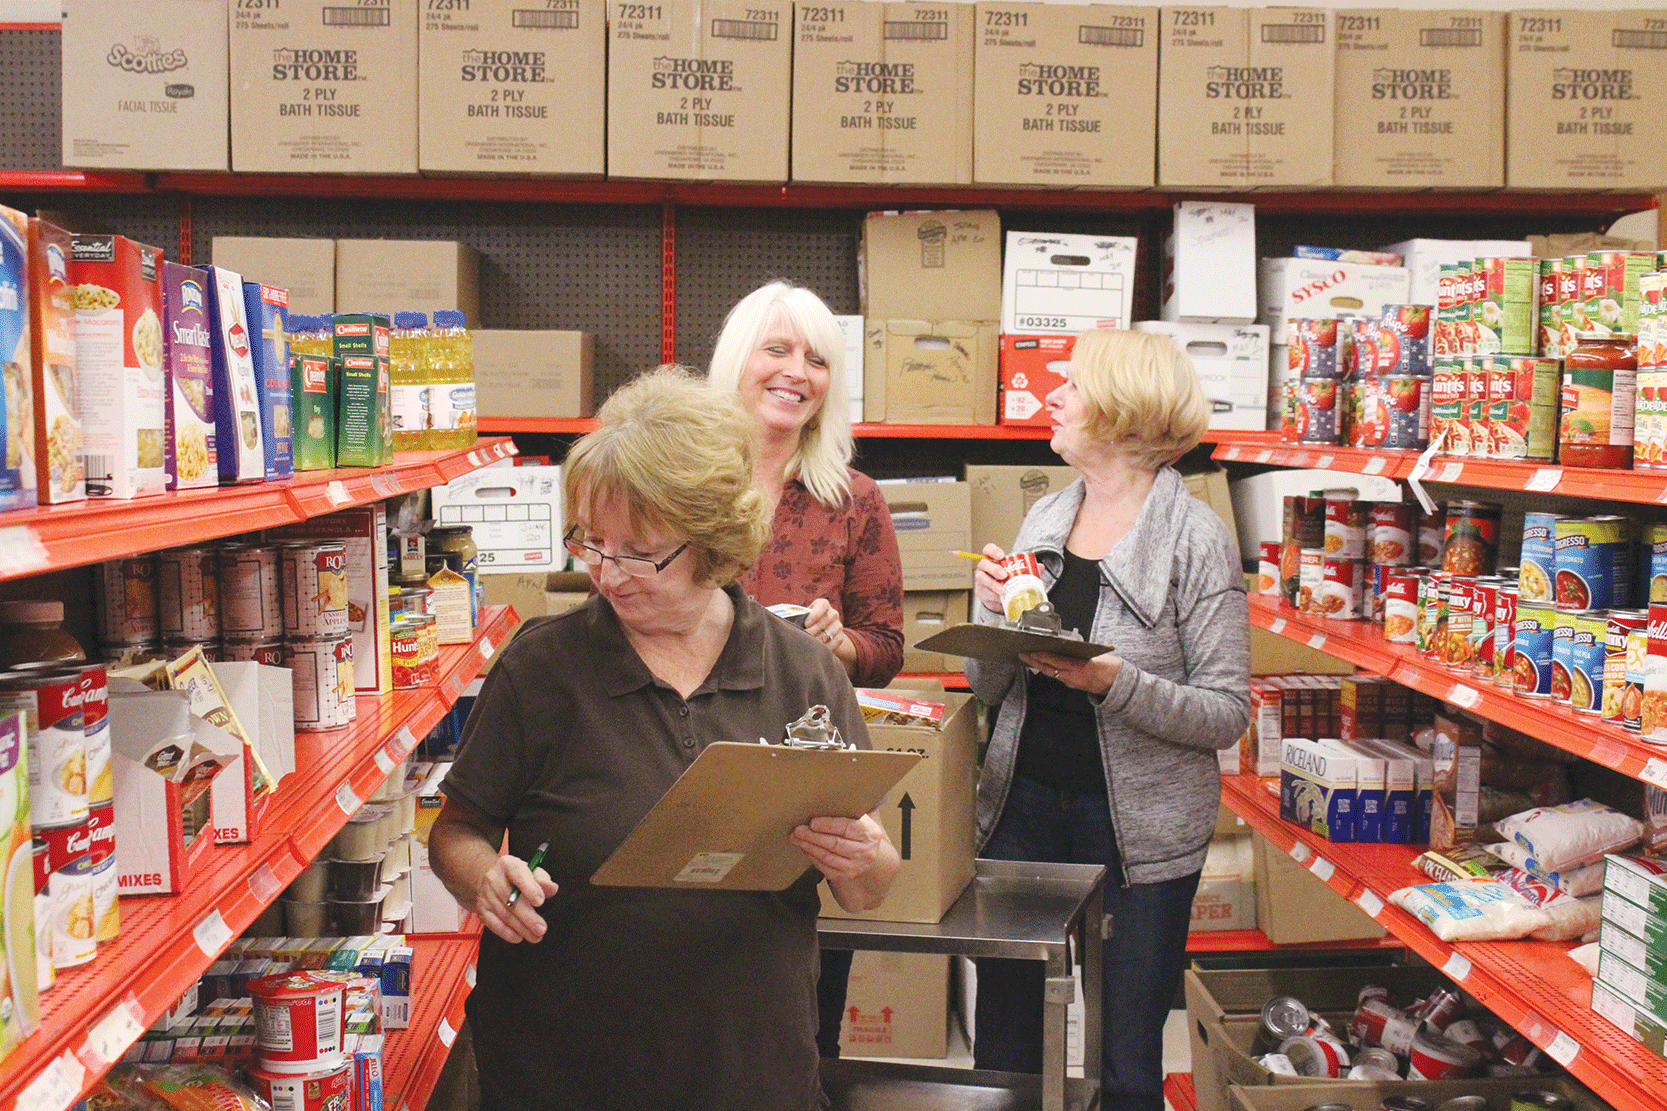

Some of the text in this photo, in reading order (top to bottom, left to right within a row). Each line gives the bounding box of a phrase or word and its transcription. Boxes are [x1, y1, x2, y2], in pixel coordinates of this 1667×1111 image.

[619, 4, 662, 20] 72311
[746, 9, 779, 20] 72311
[802, 7, 844, 23] 72311
[914, 10, 948, 20] 72311
[985, 11, 1028, 27] 72311
[1173, 11, 1214, 28] 72311
[1293, 12, 1325, 24] 72311
[1112, 16, 1145, 26] 72311
[1338, 16, 1380, 32] 72311
[1519, 17, 1562, 33] 72311
[107, 44, 188, 74] Scotties
[293, 48, 356, 64] HOME
[482, 50, 544, 65] HOME
[273, 62, 357, 81] STORE
[462, 64, 545, 82] STORE
[672, 59, 733, 74] HOME
[855, 61, 913, 77] HOME
[1039, 65, 1099, 80] HOME
[1225, 65, 1282, 82] HOME
[652, 73, 733, 91] STORE
[1392, 68, 1450, 83] HOME
[1572, 68, 1632, 84] HOME
[836, 76, 914, 94] STORE
[1018, 79, 1099, 97] STORE
[1206, 80, 1282, 99] STORE
[303, 88, 336, 101] 2 PLY
[492, 90, 524, 102] 2 PLY
[118, 100, 178, 114] FACIAL TISSUE
[280, 103, 360, 117] BATH TISSUE
[468, 105, 547, 118] BATH TISSUE
[681, 98, 712, 110] 2 PLY
[864, 101, 894, 113] 2 PLY
[1047, 104, 1078, 116] 2 PLY
[657, 113, 734, 126] BATH TISSUE
[1233, 106, 1263, 119] 2 PLY
[1401, 106, 1431, 118] 2 PLY
[1581, 107, 1612, 119] 2 PLY
[842, 116, 916, 129] BATH TISSUE
[1023, 119, 1101, 132] BATH TISSUE
[1211, 122, 1284, 135] BATH TISSUE
[1379, 121, 1453, 134] BATH TISSUE
[1557, 122, 1634, 135] BATH TISSUE
[71, 240, 112, 252] Essential
[1292, 270, 1346, 304] SYSCO
[1019, 317, 1067, 328] #03325
[1286, 745, 1327, 777] RICELAND
[118, 872, 162, 887] MIXES
